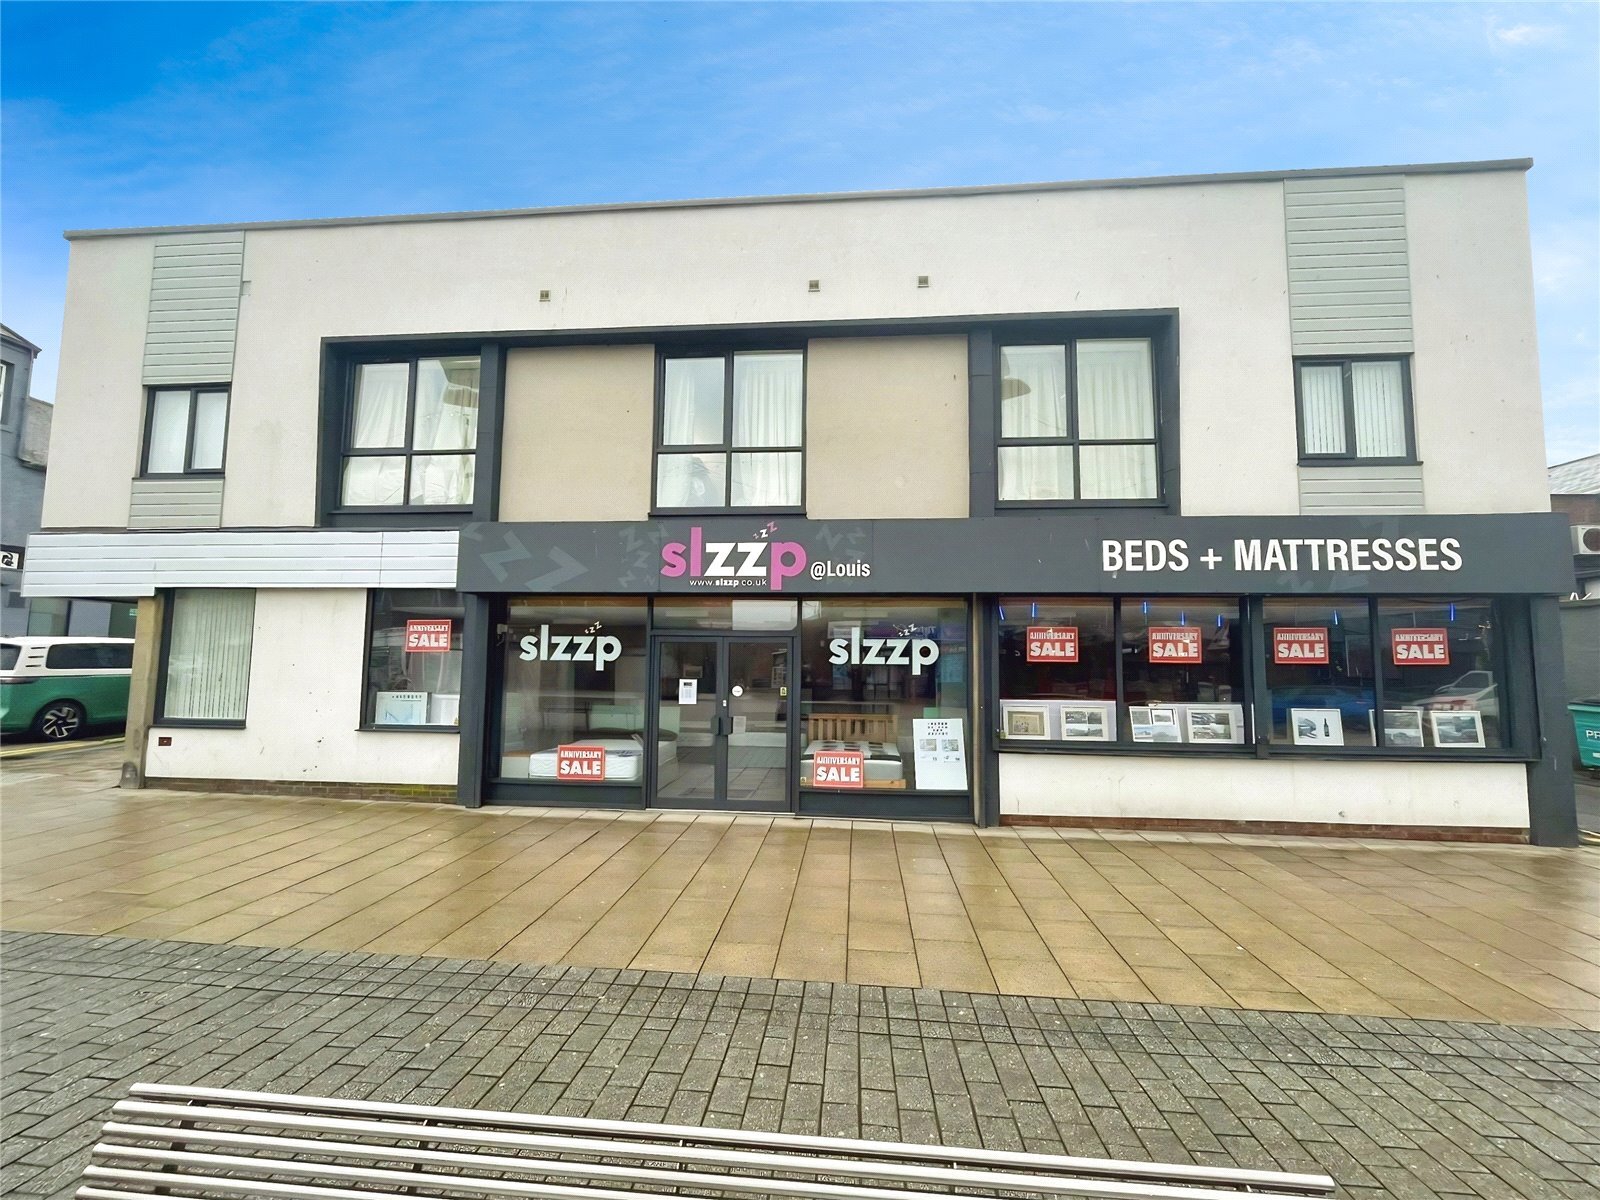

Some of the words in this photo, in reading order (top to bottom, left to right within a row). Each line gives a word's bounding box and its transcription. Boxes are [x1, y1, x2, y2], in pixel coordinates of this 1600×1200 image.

[660, 526, 807, 591] slzzp
[810, 559, 871, 580] @Louis
[1101, 538, 1190, 572] BEDS
[1199, 548, 1223, 570] +
[1234, 537, 1463, 572] MATTRESSES
[408, 633, 448, 648] SALE
[519, 624, 622, 672] slzzp
[828, 626, 940, 676] slzzp
[1030, 641, 1075, 657] SALE
[1152, 642, 1199, 658] SALE
[1278, 643, 1324, 658] SALE
[1396, 644, 1444, 660] SALE
[559, 760, 602, 775] SALE
[816, 767, 860, 783] SALE
